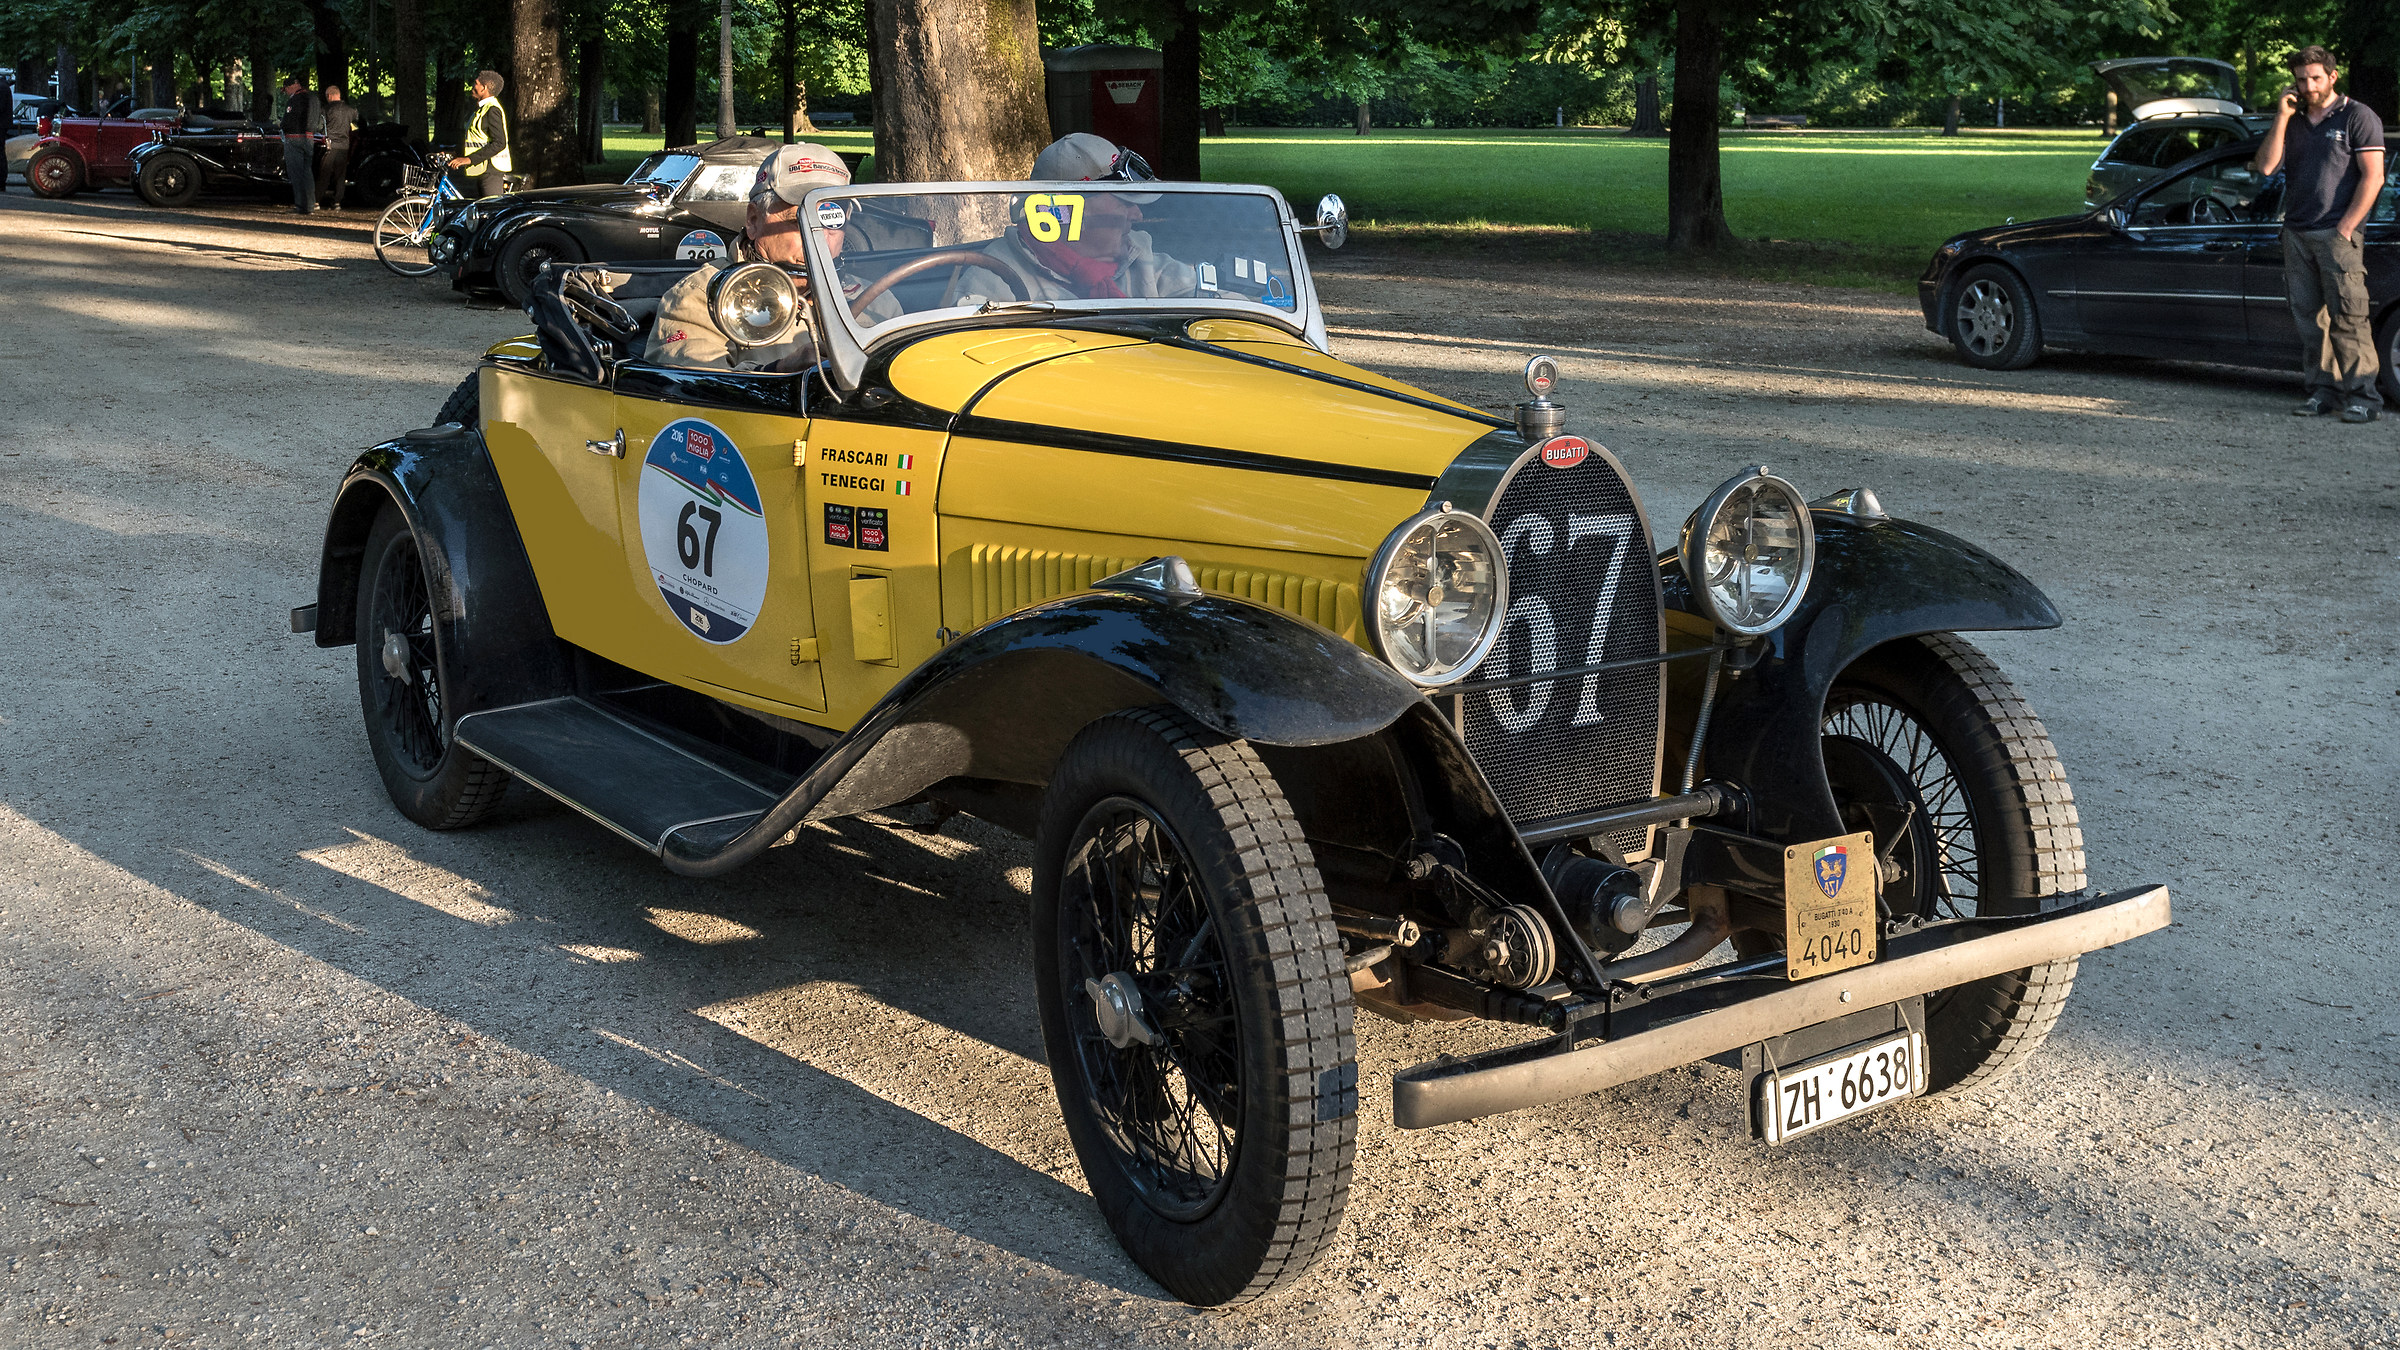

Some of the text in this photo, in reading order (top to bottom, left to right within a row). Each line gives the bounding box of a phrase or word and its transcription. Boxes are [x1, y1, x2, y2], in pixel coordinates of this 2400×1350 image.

[1024, 193, 1085, 243] 67
[671, 428, 684, 443] 2016
[690, 432, 709, 446] 1000
[688, 443, 709, 457] MIGLIA
[821, 448, 888, 467] FRASCARI
[1546, 447, 1585, 460] BUGATTI
[821, 473, 885, 492] TENEGGI
[861, 518, 884, 526] verificato
[677, 500, 721, 578] 67
[682, 573, 718, 595] CHOPARD
[1485, 512, 1635, 734] 67
[1814, 910, 1836, 921] BUGATTI
[1828, 919, 1841, 929] 1930
[1803, 928, 1862, 966] 4040
[1841, 1046, 1908, 1110] 6638
